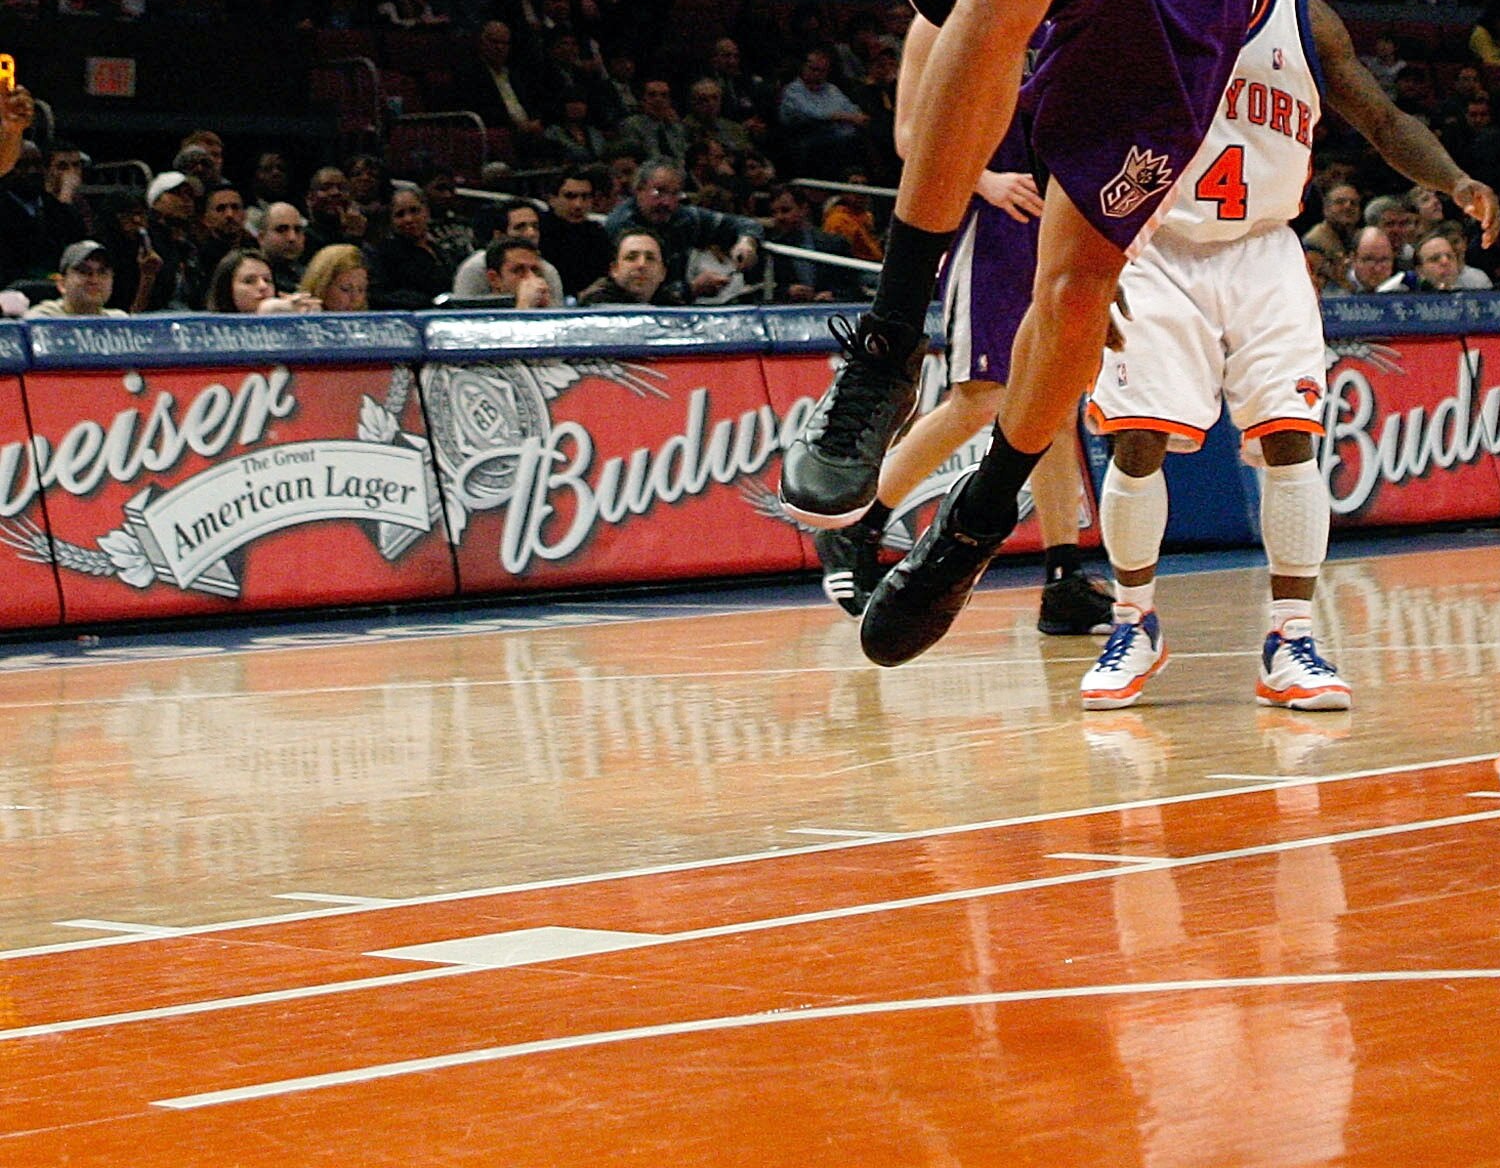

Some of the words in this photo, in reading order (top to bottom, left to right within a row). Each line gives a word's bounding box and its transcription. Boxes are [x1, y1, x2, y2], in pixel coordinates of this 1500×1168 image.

[1195, 144, 1248, 220] 4
[241, 453, 270, 474] The
[273, 448, 315, 469] Great
[175, 472, 316, 561] American
[325, 465, 417, 509] Lager
